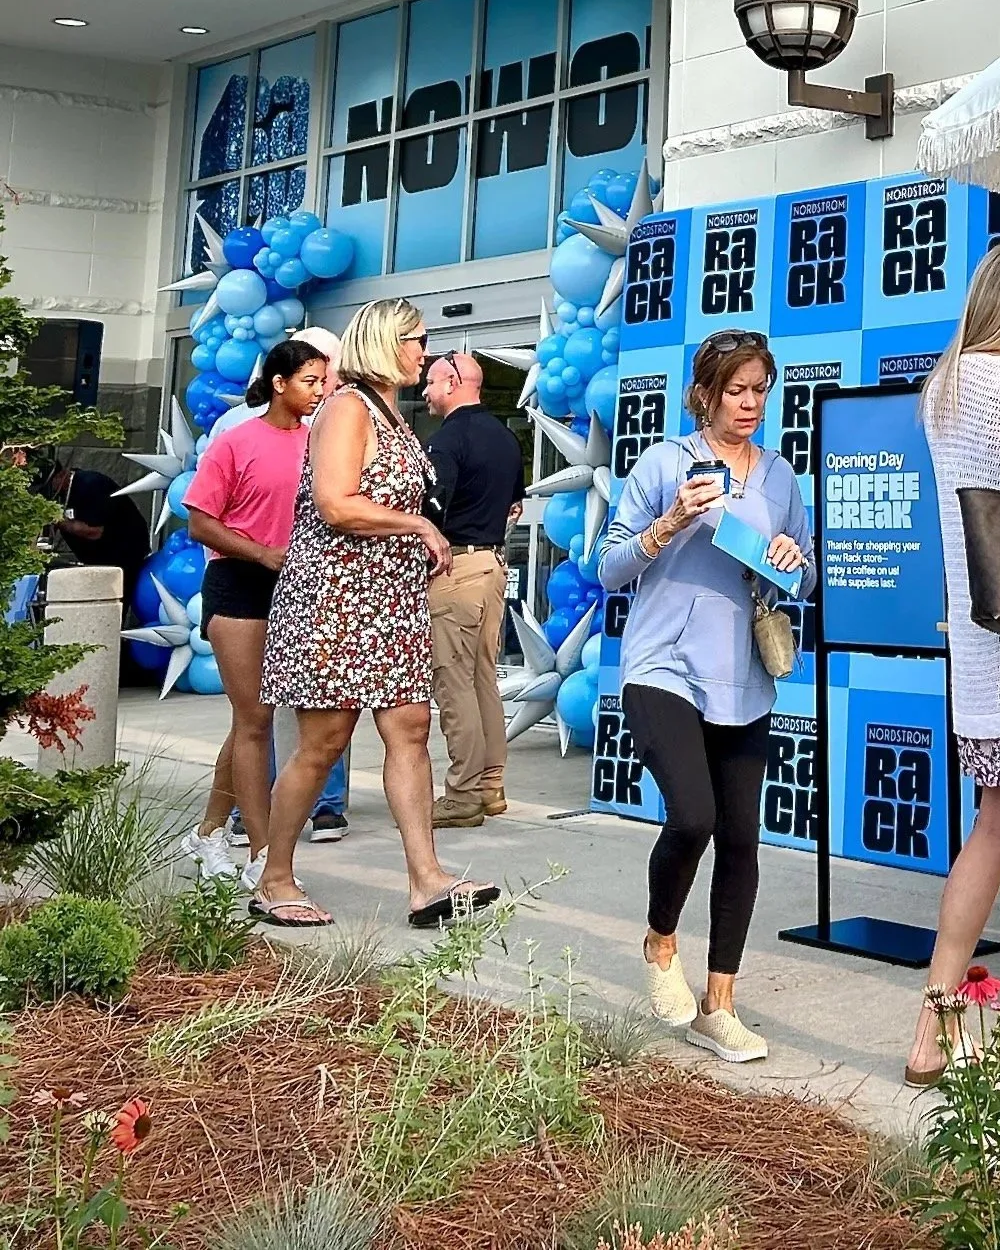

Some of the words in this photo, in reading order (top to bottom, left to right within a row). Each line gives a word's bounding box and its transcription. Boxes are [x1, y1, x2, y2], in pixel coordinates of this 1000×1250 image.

[341, 52, 557, 207] NOW
[567, 25, 651, 157] O
[886, 182, 945, 201] NORDSTROM
[793, 199, 846, 216] NORDSTROM
[708, 212, 757, 227] NORDSTROM
[631, 222, 675, 239] NORDSTROM
[786, 365, 840, 379] NORDSTROM
[621, 377, 666, 391] NORDSTROM
[826, 452, 877, 472] Opening
[879, 451, 904, 470] Day
[826, 472, 919, 501] COFFEE
[827, 540, 852, 550] Thanks
[853, 540, 864, 550] for
[865, 541, 900, 553] shopping
[902, 543, 920, 553] your
[843, 552, 861, 562] Rack
[827, 566, 845, 576] enjoy
[852, 565, 876, 575] coffee
[827, 577, 848, 586] While
[848, 578, 879, 589] supplies
[868, 728, 930, 746] NORDSTROM
